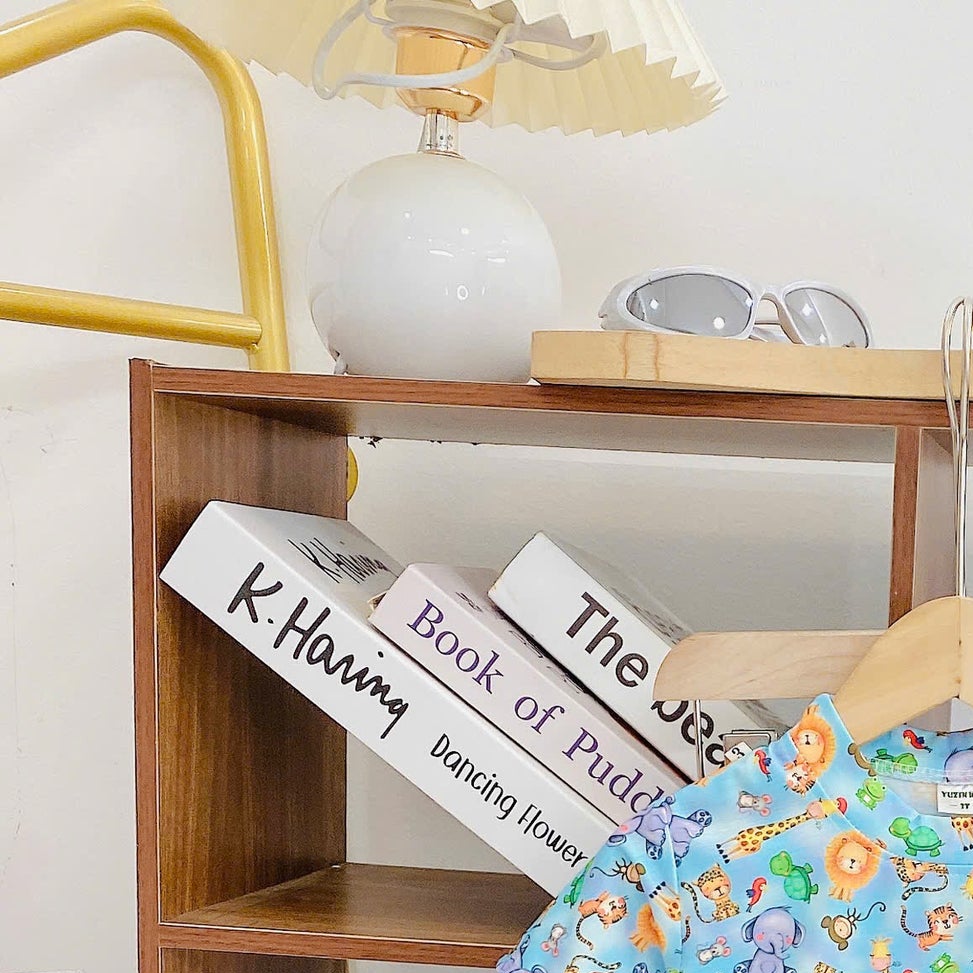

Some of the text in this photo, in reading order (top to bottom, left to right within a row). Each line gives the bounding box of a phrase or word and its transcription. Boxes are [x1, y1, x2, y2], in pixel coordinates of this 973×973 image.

[407, 599, 504, 694] Book
[514, 696, 565, 734] of
[566, 591, 649, 688] The
[430, 733, 588, 868] Dancing Flower
[941, 790, 968, 799] YUZIN
